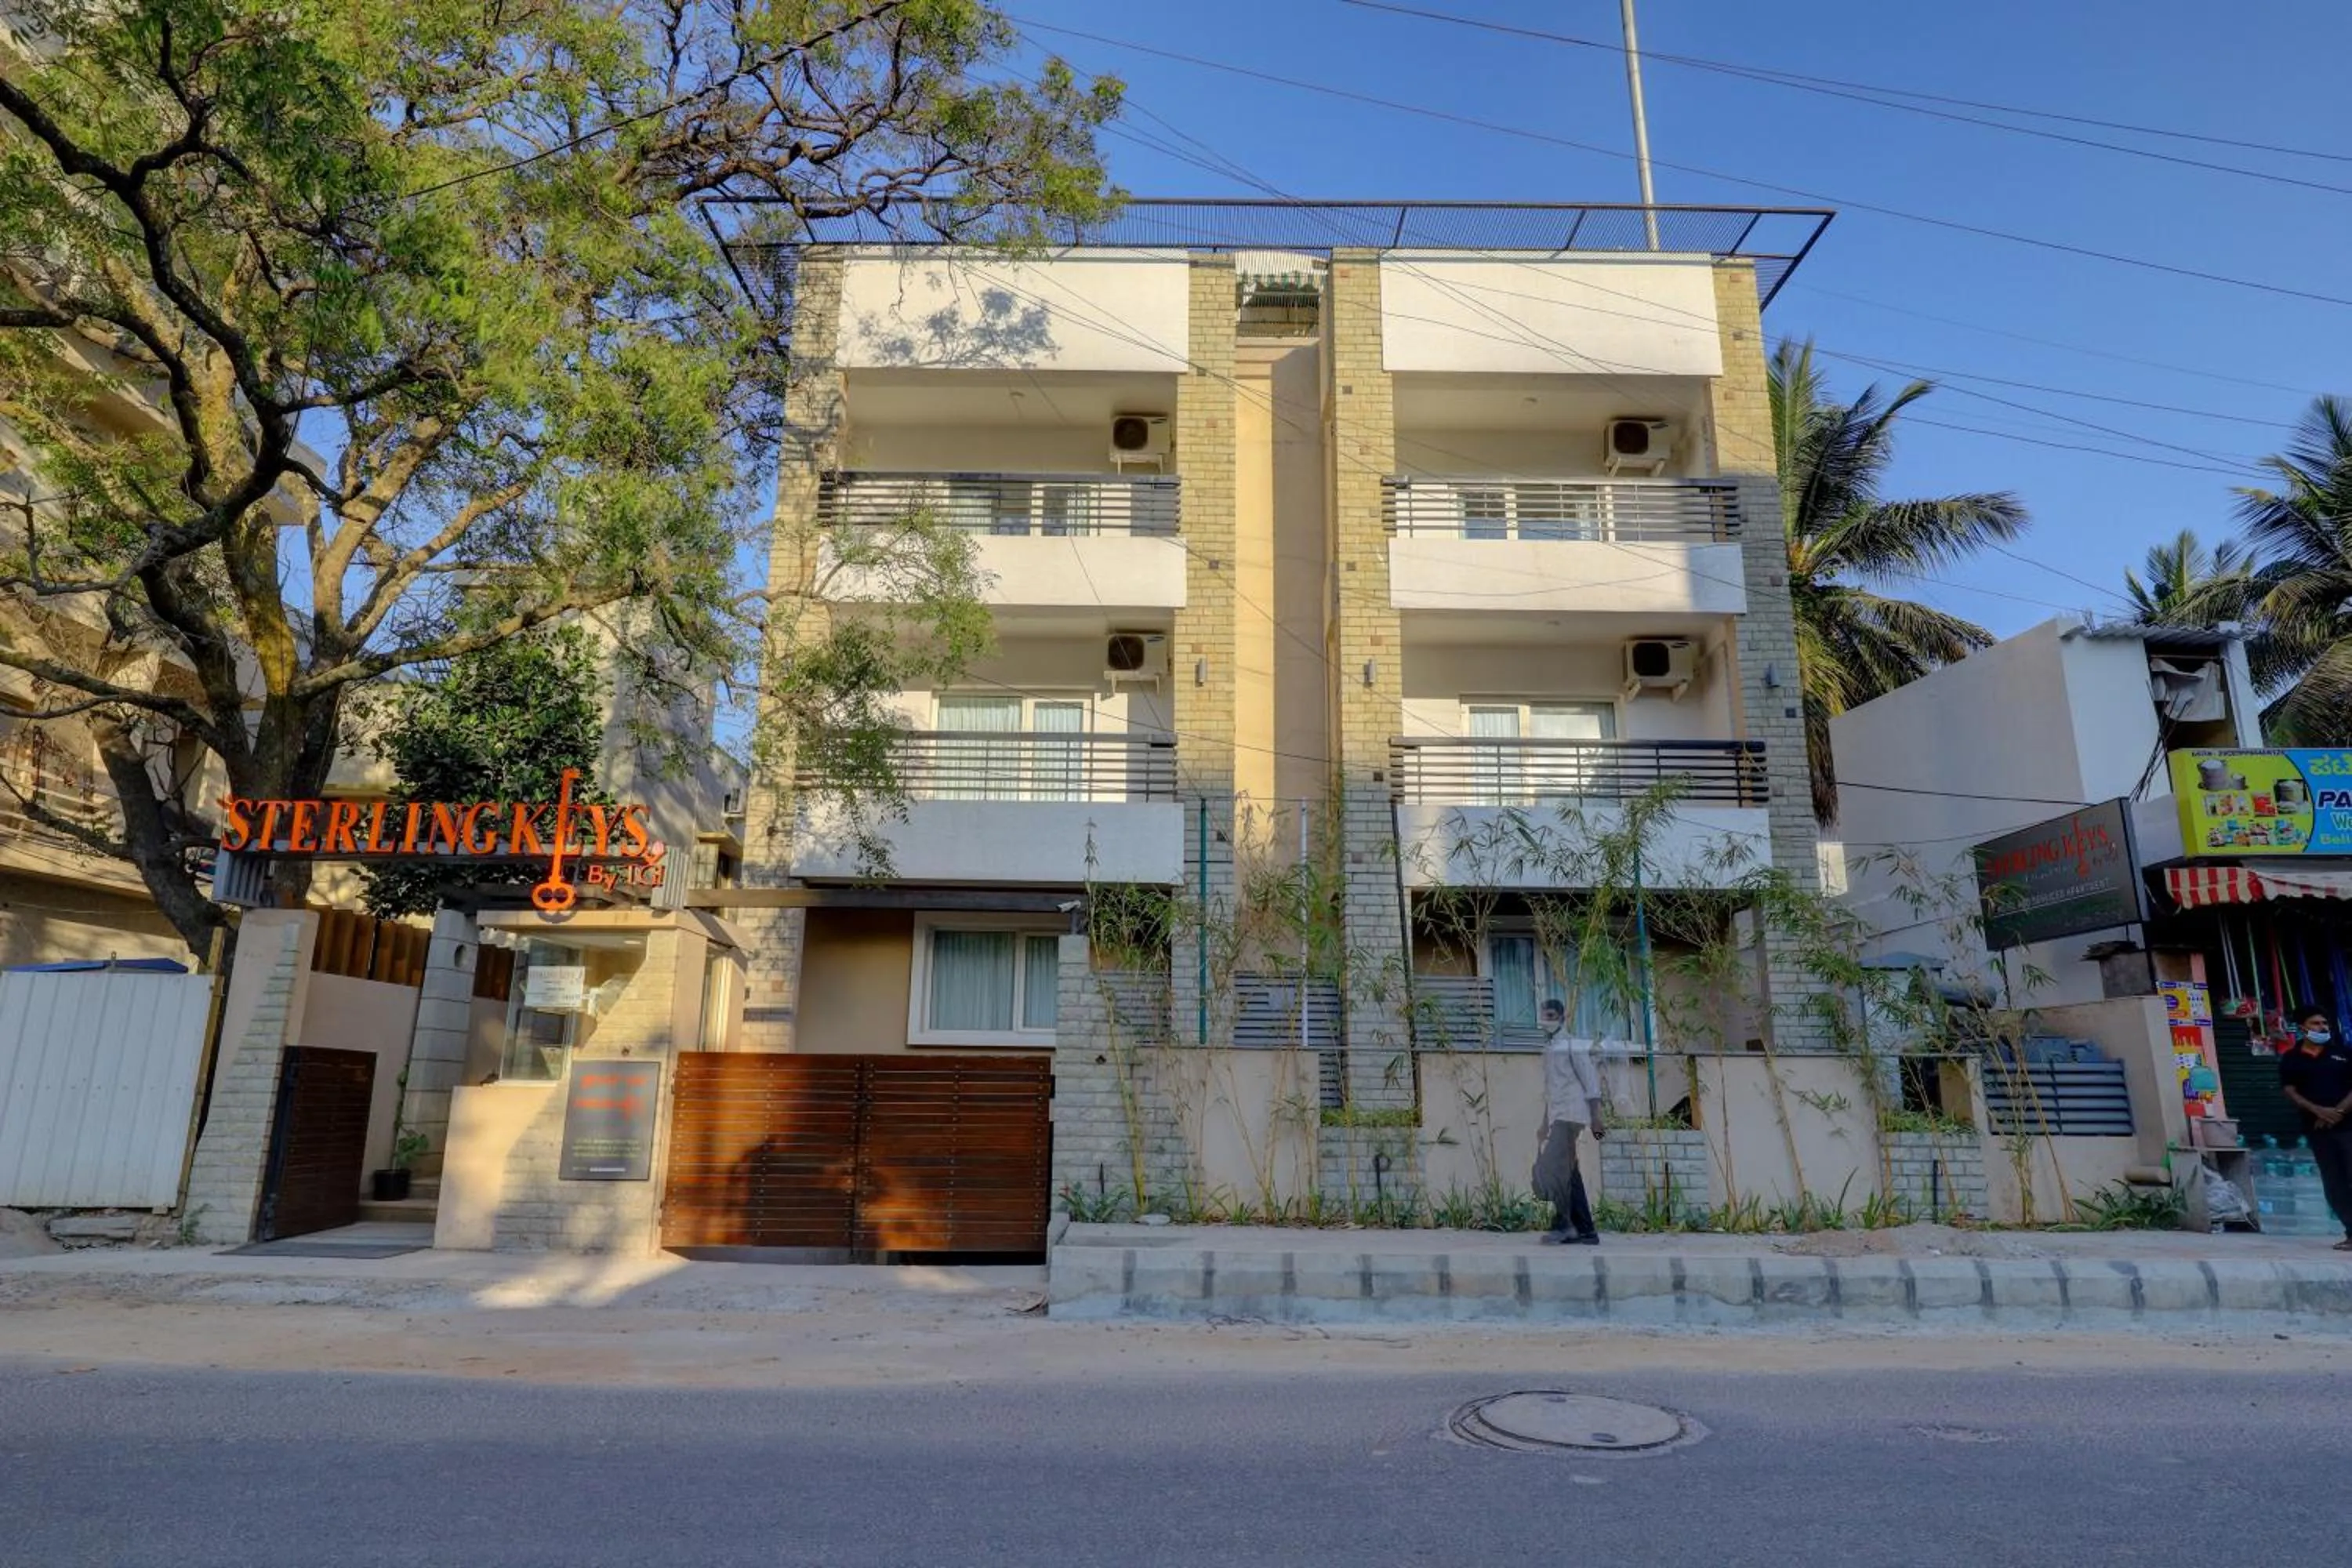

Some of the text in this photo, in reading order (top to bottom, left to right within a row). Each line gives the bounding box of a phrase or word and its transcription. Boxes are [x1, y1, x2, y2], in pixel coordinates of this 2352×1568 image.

[223, 799, 652, 857] STERLING KEYS
[588, 865, 619, 893] By
